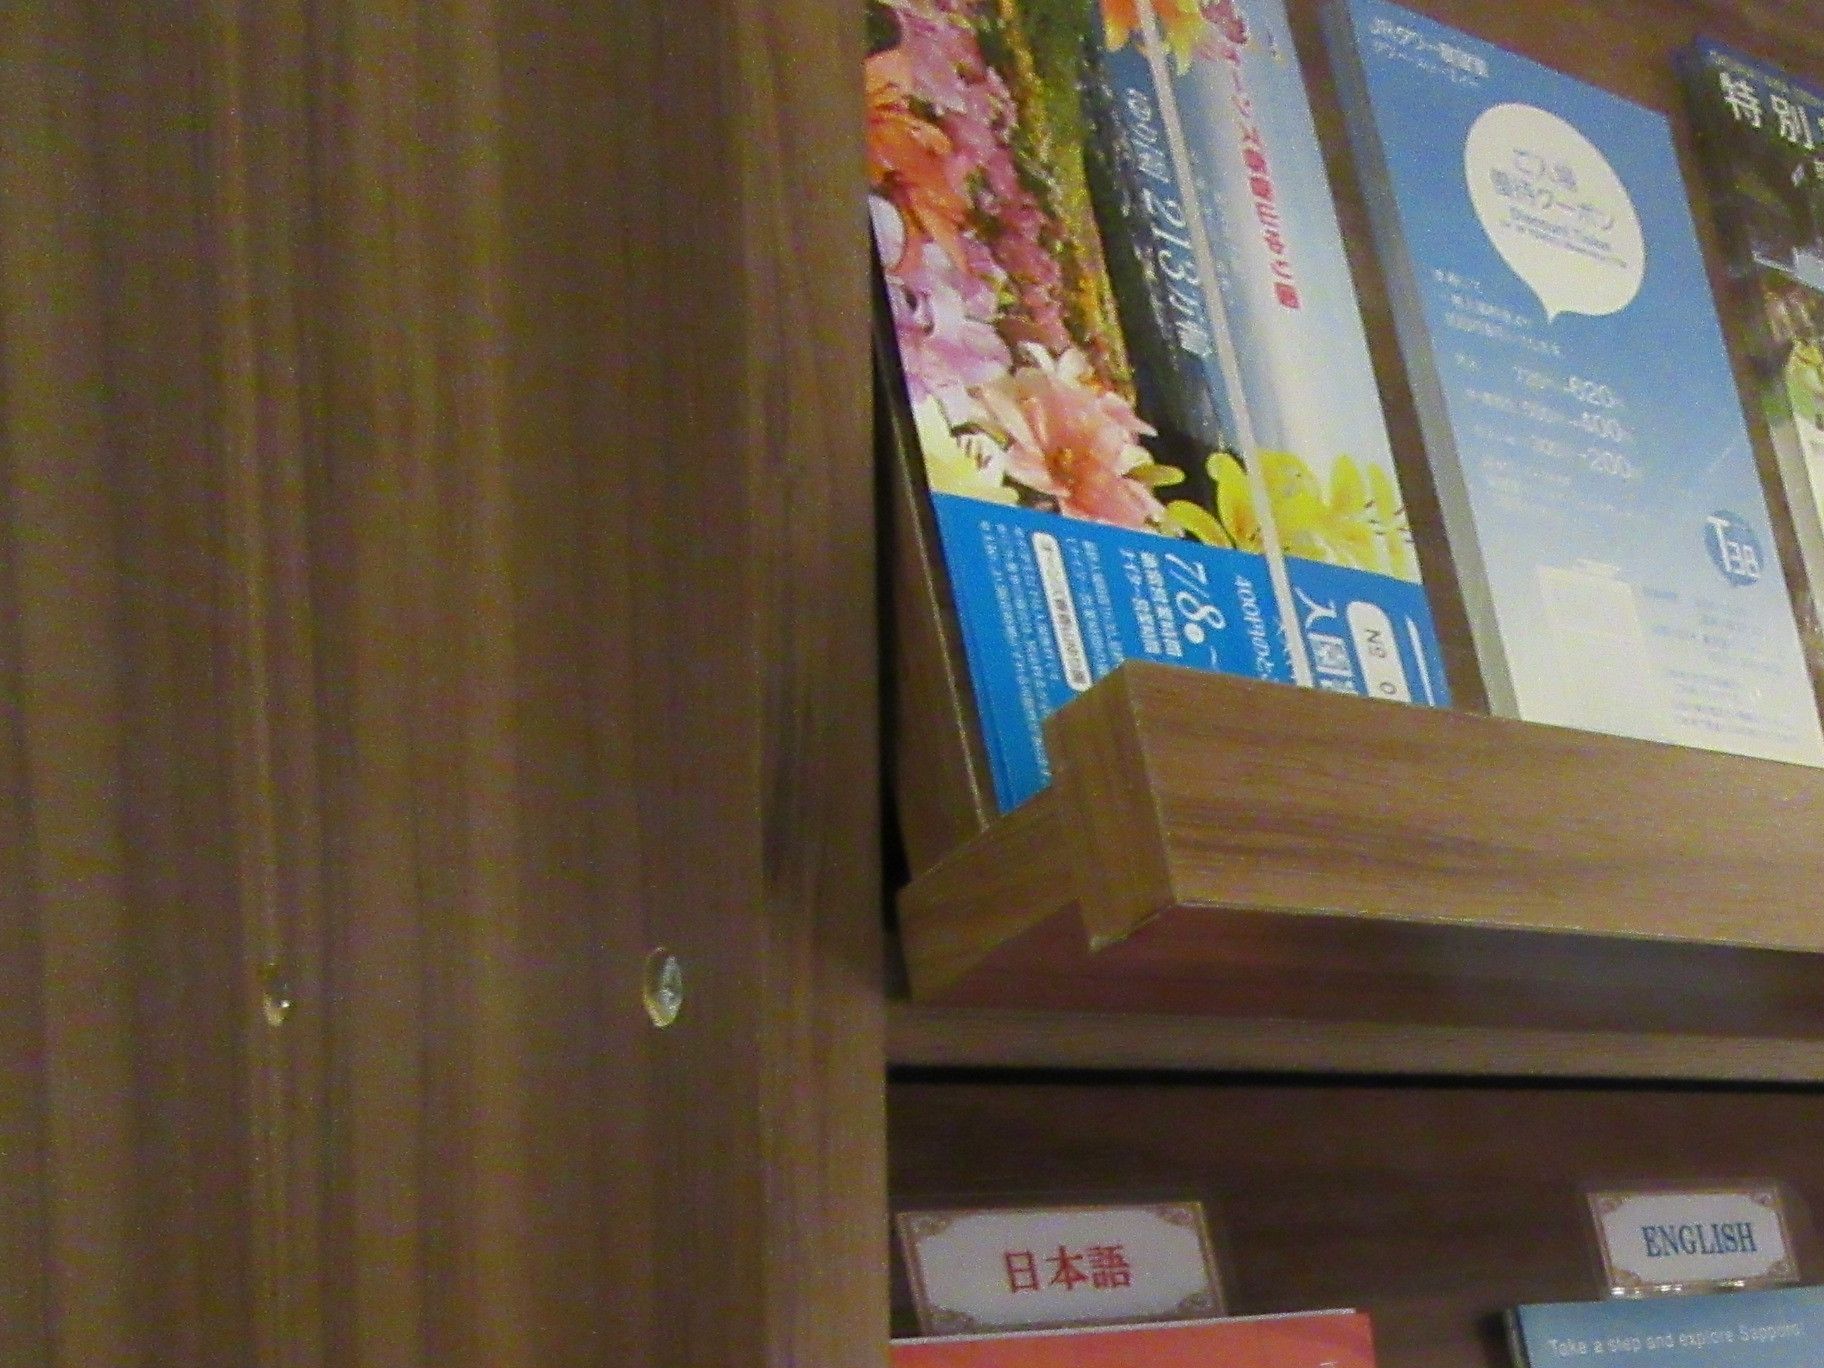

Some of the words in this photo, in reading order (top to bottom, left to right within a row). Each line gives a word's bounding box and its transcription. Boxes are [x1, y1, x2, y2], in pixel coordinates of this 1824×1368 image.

[1641, 1222, 1758, 1258] ENGLISH
[1002, 1246, 1134, 1294] 日本語
